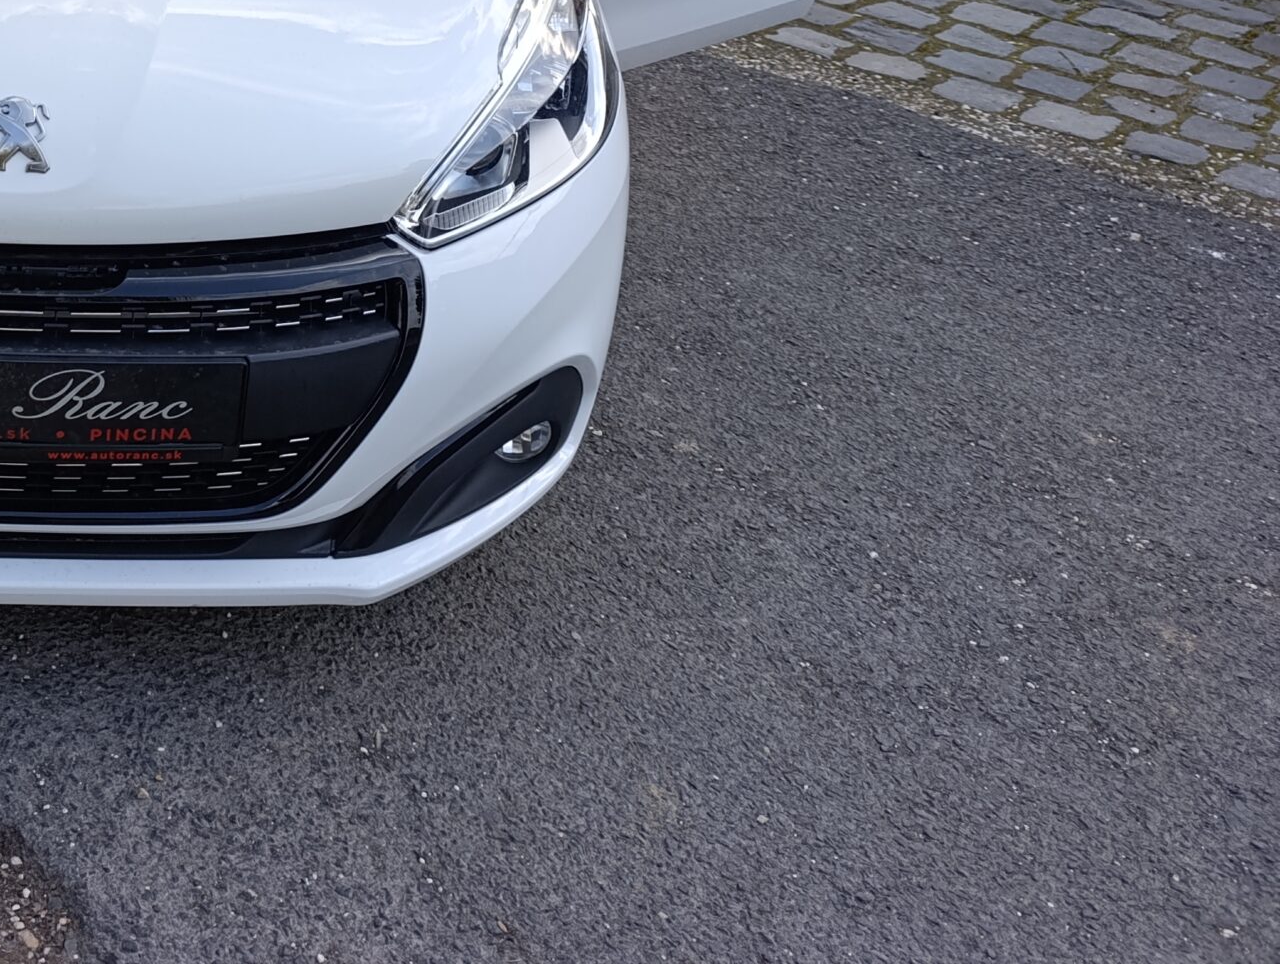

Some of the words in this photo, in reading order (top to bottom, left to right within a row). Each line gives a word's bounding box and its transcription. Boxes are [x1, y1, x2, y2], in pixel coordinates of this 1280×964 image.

[11, 369, 193, 420] Ranc
[89, 427, 192, 441] PINCINA
[47, 450, 182, 460] www.autoranc.sk
